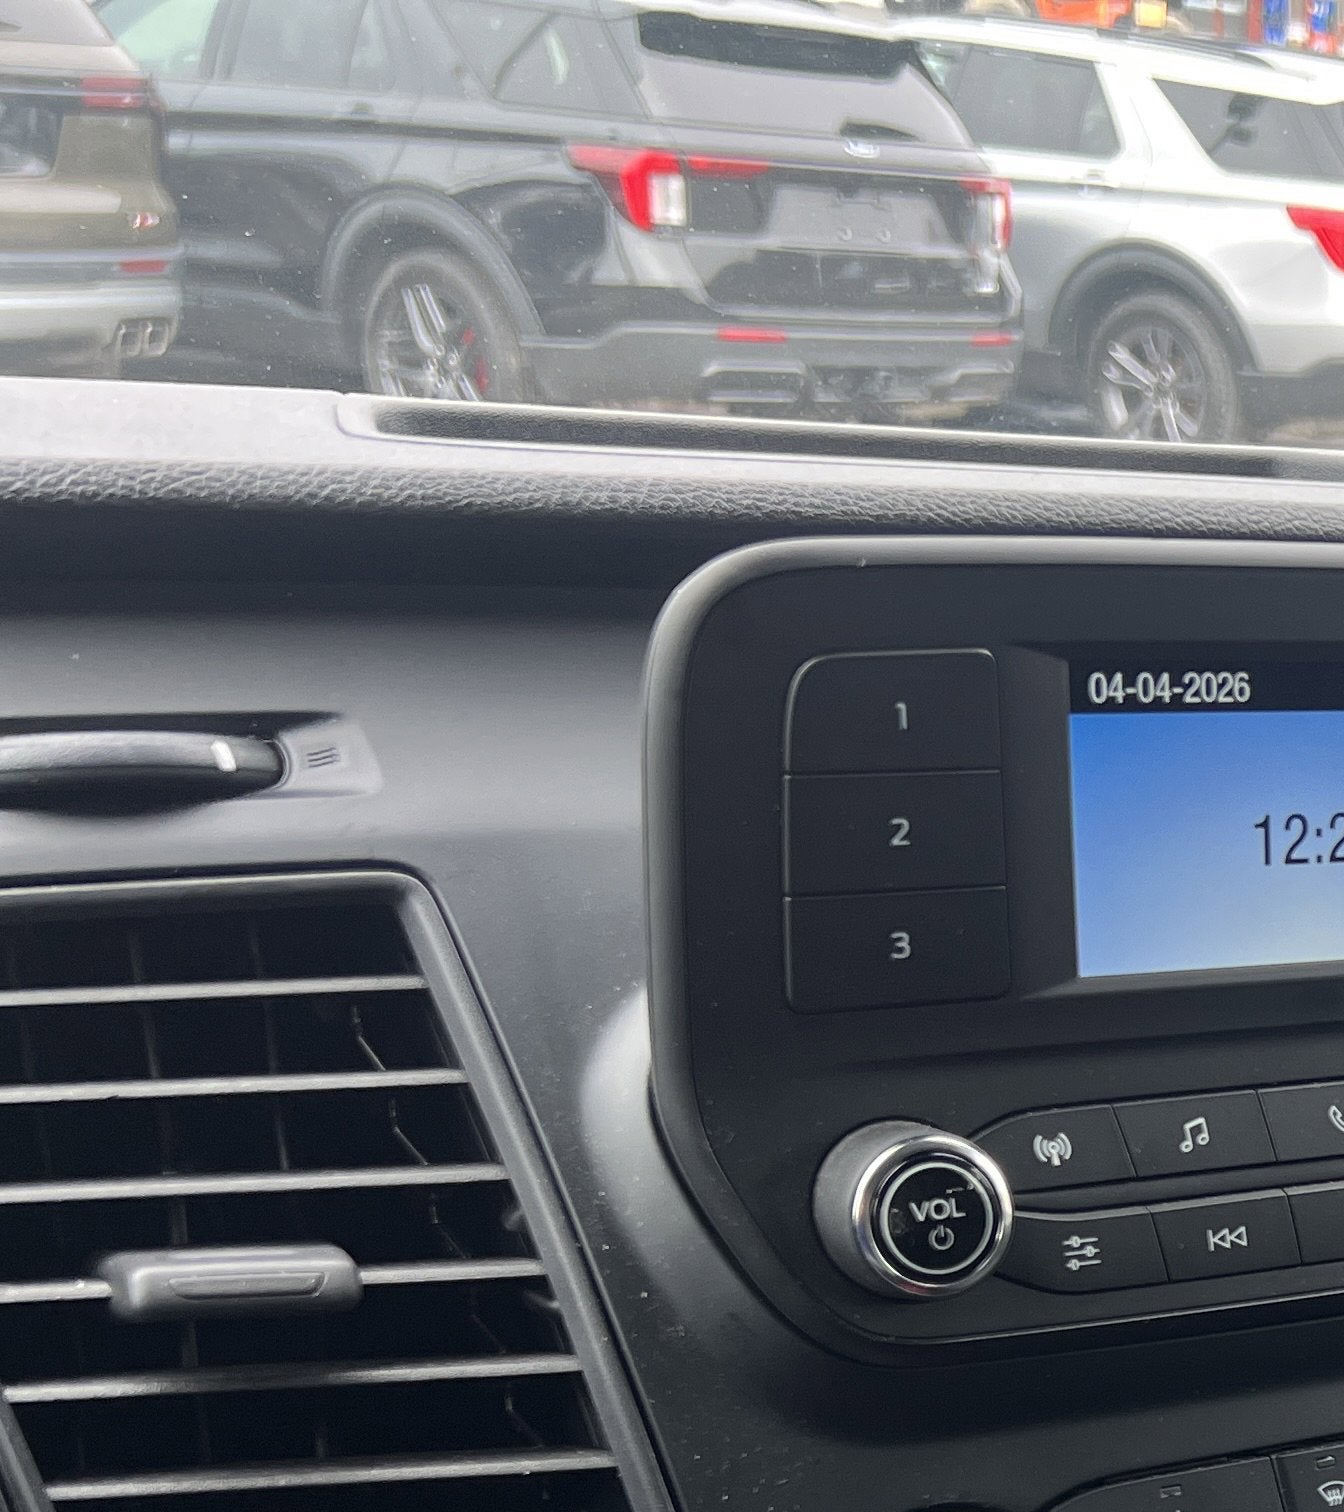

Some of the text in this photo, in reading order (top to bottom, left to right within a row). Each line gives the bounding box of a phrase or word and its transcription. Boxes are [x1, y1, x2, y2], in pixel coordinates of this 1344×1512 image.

[1087, 671, 1252, 704] 04-04-2026
[893, 702, 910, 730] 1
[888, 817, 912, 847] 2
[889, 932, 912, 960] 3
[909, 1198, 966, 1223] VOL
